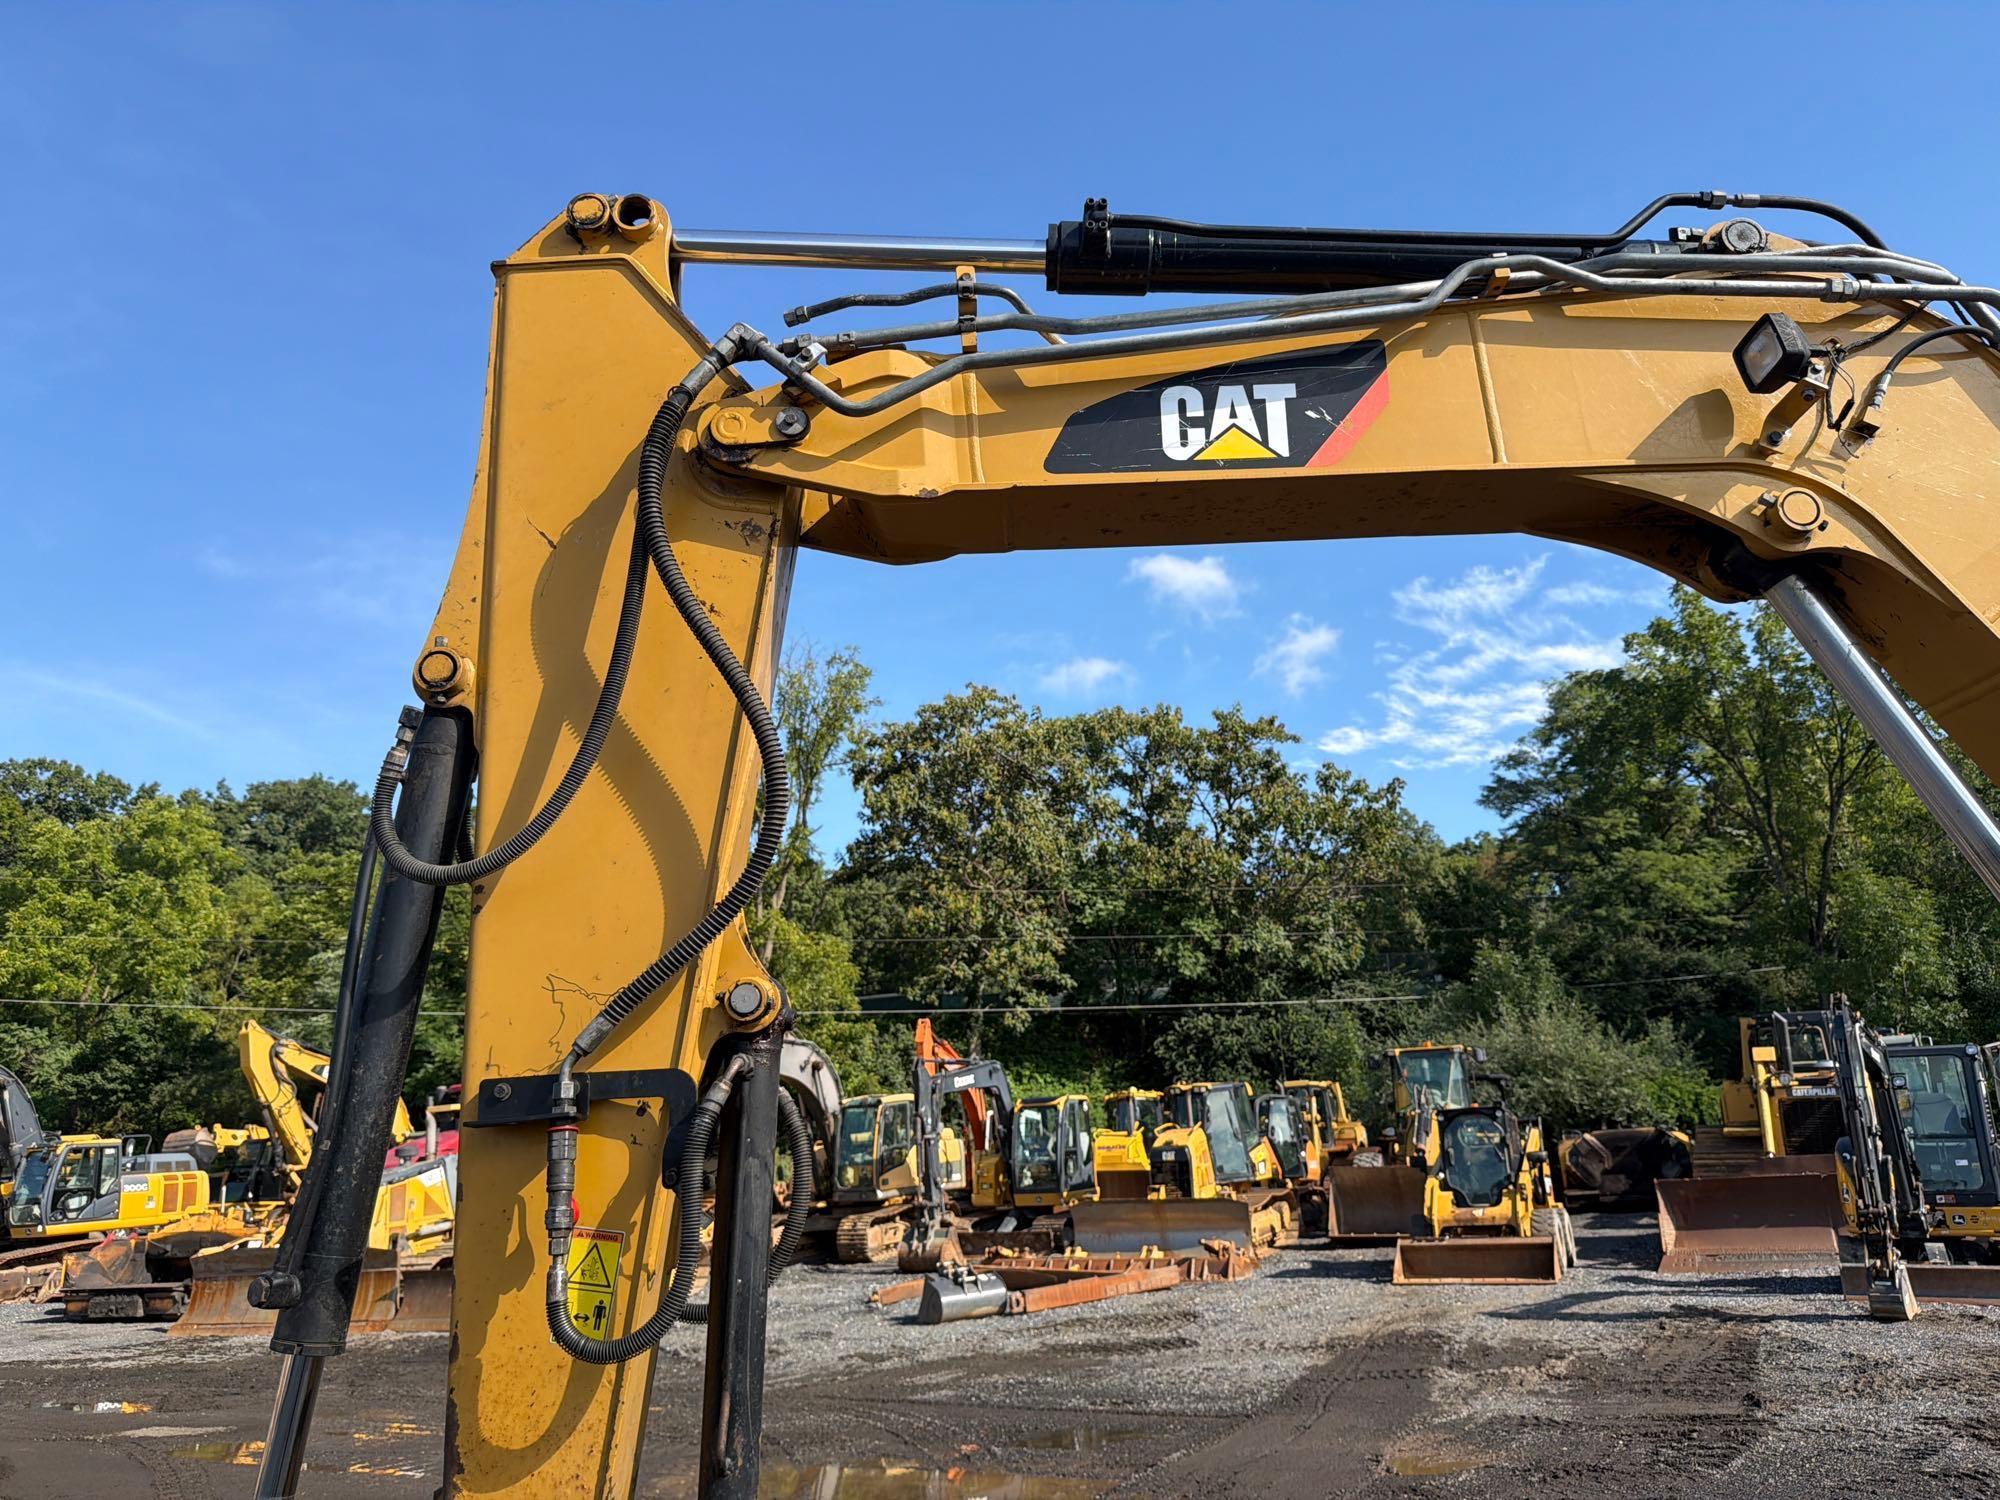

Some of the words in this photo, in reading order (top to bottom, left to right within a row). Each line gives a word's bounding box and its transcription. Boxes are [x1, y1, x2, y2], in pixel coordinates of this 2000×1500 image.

[1160, 383, 1297, 461] CAT
[1791, 1088, 1836, 1096] CATERPILLAR
[585, 1231, 619, 1241] WARNING
